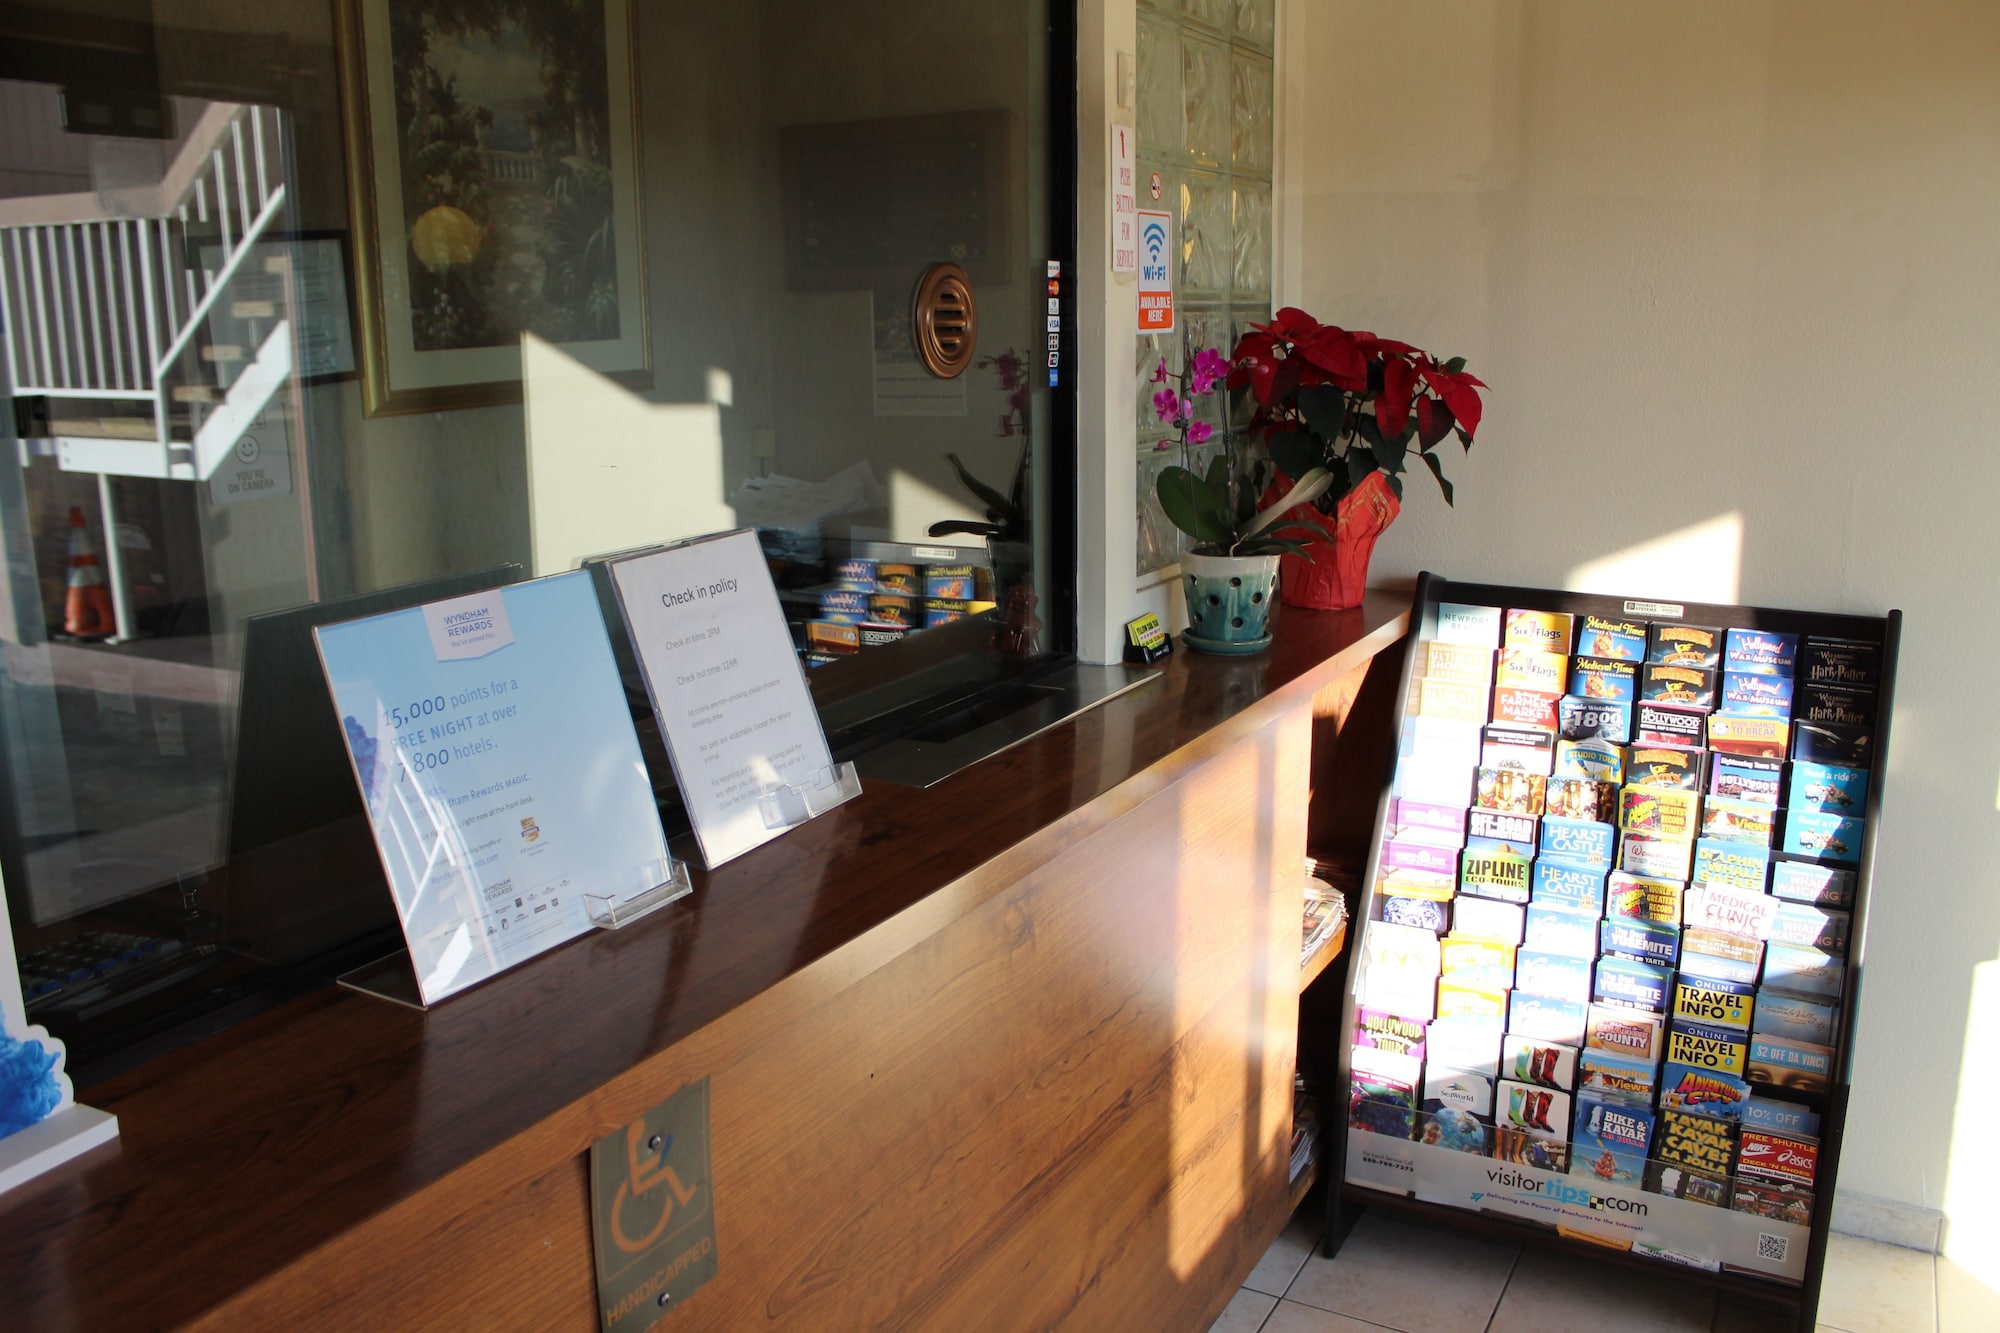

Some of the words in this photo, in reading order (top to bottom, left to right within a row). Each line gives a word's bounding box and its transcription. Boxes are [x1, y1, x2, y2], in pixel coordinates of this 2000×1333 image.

[1120, 168, 1131, 186] PUSH
[1116, 194, 1134, 213] BUTTON
[1121, 222, 1130, 240] FOR
[1116, 250, 1134, 268] SERVICE
[1143, 266, 1166, 280] Wi-Fi
[1140, 296, 1171, 309] AVAILABLE
[1049, 320, 1059, 328] VISA
[1148, 309, 1163, 322] HERE
[242, 478, 275, 492] CAMERA
[662, 587, 695, 607] Check
[696, 585, 707, 599] in
[709, 578, 738, 598] policy
[443, 608, 489, 625] WYNDHAM
[1445, 614, 1488, 624] NEWPORT
[447, 620, 493, 637] REWARDS
[1513, 626, 1528, 635] Six
[1536, 628, 1561, 639] Flags
[1586, 616, 1623, 632] Medieval
[1622, 623, 1646, 637] Times
[666, 637, 684, 650] Check
[1576, 657, 1612, 673] Medieval
[1612, 663, 1635, 675] Times
[1730, 650, 1751, 661] WAX
[1752, 653, 1791, 665] MUSEUM
[676, 672, 695, 685] Check
[696, 669, 706, 680] out
[1509, 663, 1524, 672] Six
[1532, 666, 1557, 678] Flags
[1811, 665, 1838, 682] Harry
[1837, 664, 1867, 681] Potter
[384, 696, 445, 729] 15,000
[450, 685, 490, 710] points
[491, 680, 508, 696] for
[510, 679, 518, 690] a
[1501, 694, 1554, 709] FARMERS
[1726, 690, 1749, 702] WAX
[1750, 694, 1788, 706] MUSEUM
[1502, 705, 1551, 720] MARKET
[1641, 711, 1700, 728] HOLLYWOOD
[1809, 706, 1836, 722] Harry
[1835, 706, 1865, 724] Potter
[430, 716, 473, 740] NIGHT
[478, 713, 490, 726] at
[492, 704, 518, 721] over
[1746, 727, 1775, 737] BREAK
[453, 737, 498, 760] hotels.
[1568, 751, 1596, 760] STUDIO
[1598, 754, 1618, 766] TOUR
[1834, 771, 1858, 782] ride?
[470, 782, 505, 800] Rewards
[505, 773, 531, 787] MAGIC.
[477, 812, 488, 821] now
[1471, 813, 1533, 831] OFF-ROAD
[1734, 817, 1771, 832] Views
[1549, 825, 1608, 842] HEARST
[1552, 838, 1605, 855] CASTLE
[1466, 859, 1525, 880] ZIPLINE
[1541, 866, 1599, 887] HEARST
[1708, 862, 1763, 881] WHALE
[1465, 876, 1485, 884] ECO
[1491, 877, 1524, 888] TOURS
[1544, 879, 1596, 897] CASTLE
[1777, 883, 1839, 900] WATCHING
[1649, 903, 1674, 914] RECORD
[1709, 892, 1767, 917] MEDICAL
[1706, 904, 1761, 929] CLINIC
[1611, 934, 1673, 956] YOSEMITE
[1645, 957, 1665, 966] YARTS
[1600, 979, 1662, 1001] YOSEMITE
[1695, 979, 1735, 993] ONLINE
[1680, 986, 1743, 1009] TRAVEL
[1680, 1001, 1725, 1019] INFO
[1366, 1014, 1422, 1038] HOLLYWOOD
[1688, 1027, 1728, 1041] ONLINE
[1596, 1031, 1648, 1049] COUNTY
[1673, 1033, 1736, 1056] TRAVEL
[1673, 1047, 1718, 1066] INFO
[1757, 1045, 1768, 1058] $2
[1770, 1048, 1786, 1061] OFF
[1788, 1051, 1799, 1063] DA
[1584, 1062, 1649, 1081] Submarine
[1611, 1078, 1649, 1093] Views
[1675, 1072, 1742, 1102] ADVENTURE
[1440, 1090, 1474, 1102] SeaWorld
[1685, 1091, 1733, 1105] CITY
[1604, 1111, 1635, 1129] BIKE
[1636, 1121, 1647, 1132] &
[1664, 1111, 1729, 1136] KAYAK
[1748, 1106, 1772, 1121] 10%
[1775, 1112, 1801, 1125] OFF
[1601, 1131, 1615, 1140] LA
[1616, 1135, 1646, 1149] JOLLA
[1602, 1121, 1646, 1142] KAYAK
[1670, 1122, 1733, 1151] KAYAK
[1666, 1136, 1732, 1164] CAVES
[1743, 1132, 1769, 1143] FREE
[1772, 1138, 1817, 1154] SHUTTLE
[1747, 1142, 1772, 1152] NIKE
[1661, 1147, 1680, 1161] LA
[1683, 1155, 1727, 1175] JOLLA
[1743, 1158, 1768, 1167] DECK
[1780, 1165, 1810, 1177] SHOES
[1486, 1192, 1518, 1205] Delivering
[1519, 1199, 1529, 1207] the
[1531, 1202, 1552, 1210] Power
[1562, 1209, 1593, 1221] Brochures
[606, 1236, 712, 1327] HANDICAPPED
